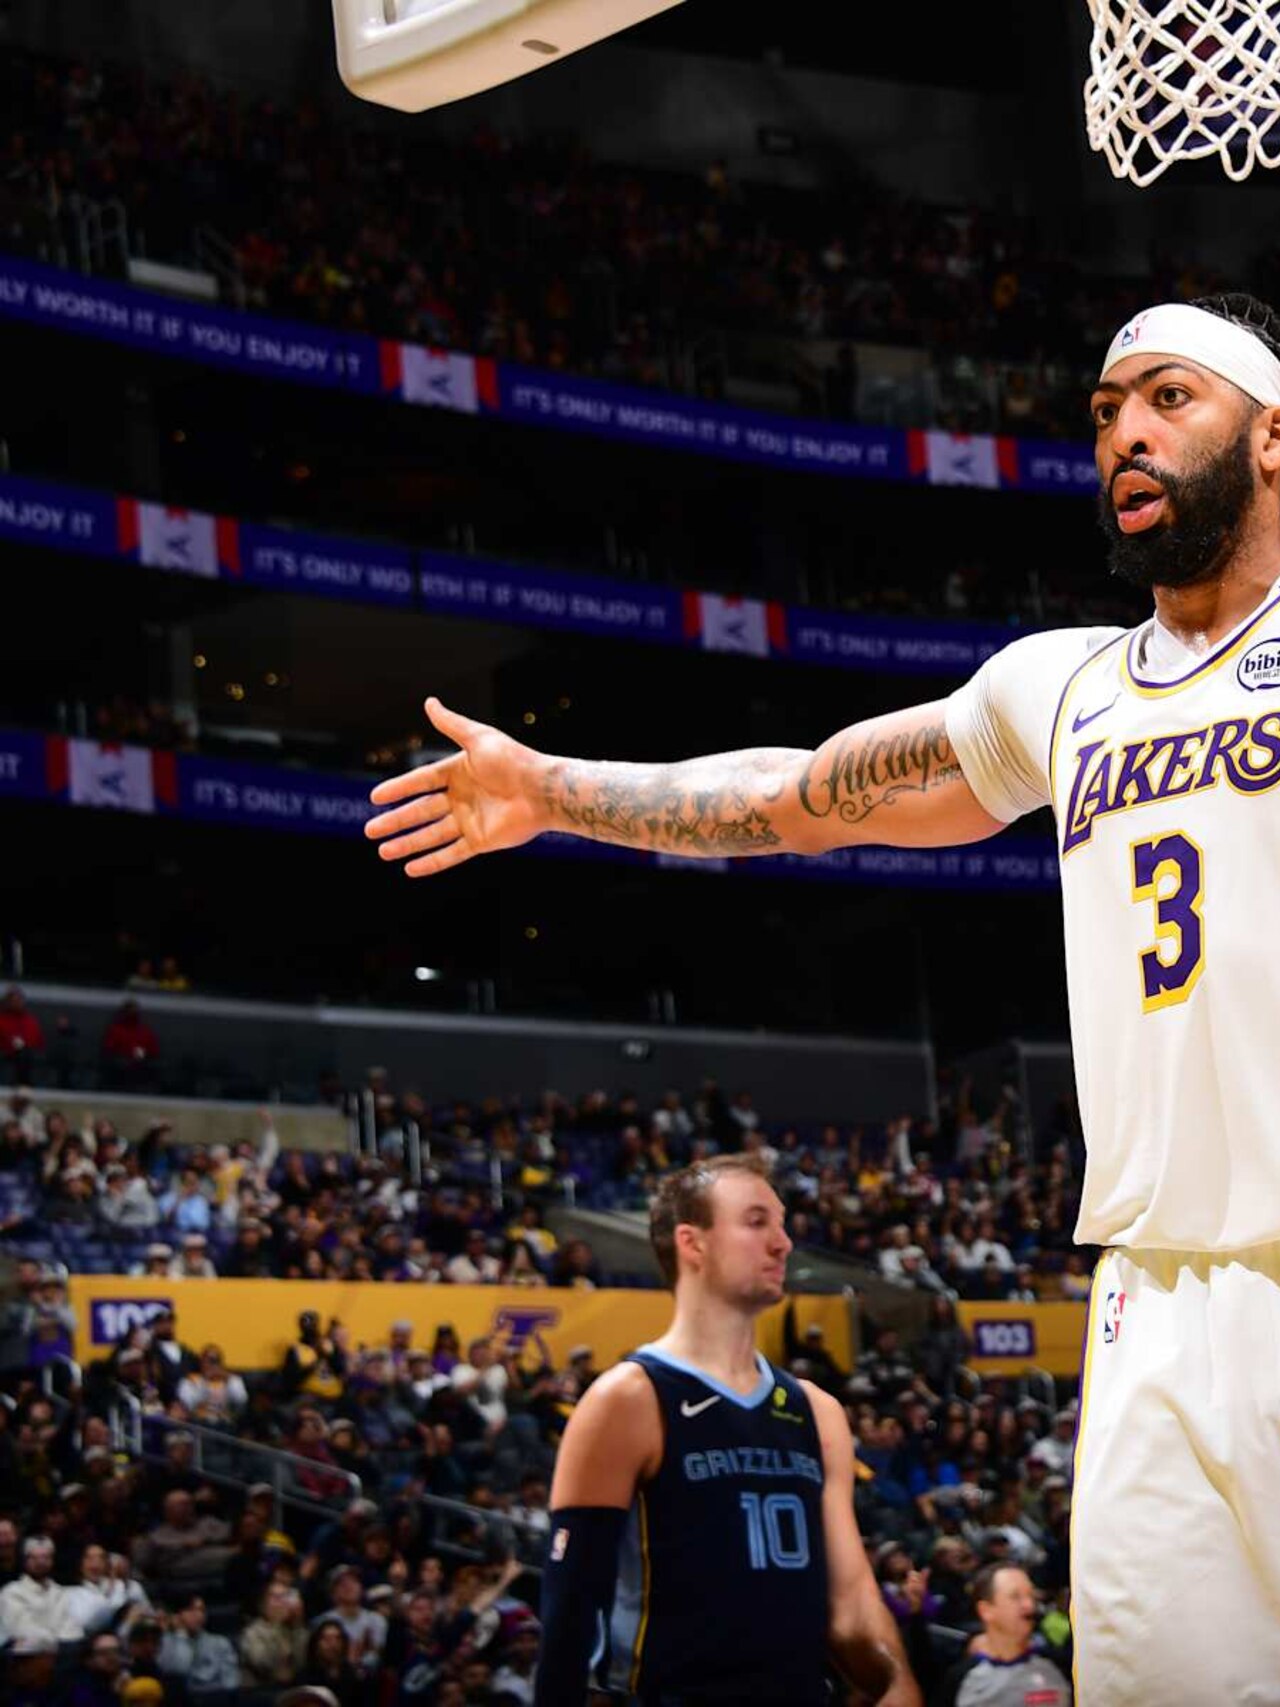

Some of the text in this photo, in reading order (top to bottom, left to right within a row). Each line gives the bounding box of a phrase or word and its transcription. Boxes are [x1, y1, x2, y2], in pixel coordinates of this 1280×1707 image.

[33, 282, 129, 330] WORTH
[132, 308, 156, 335] IT
[160, 315, 183, 341] IF
[186, 320, 243, 357] YOU
[245, 334, 328, 374] ENJOY
[333, 350, 361, 379] IT
[512, 383, 552, 415] IT'S
[556, 392, 616, 425] ONLY
[618, 406, 699, 439] WORTH
[745, 426, 788, 456] YOU
[791, 435, 863, 466] ENJOY
[1031, 456, 1070, 483] IT'S
[69, 509, 97, 539] IT
[255, 545, 668, 629] IT'S ONLY WORTH IT IF YOU ENJOY IT
[797, 625, 835, 653] IT'S
[838, 632, 890, 660] ONLY
[893, 639, 975, 662] WORTH
[193, 778, 240, 812] IT'S
[243, 784, 304, 822] ONLY
[1130, 829, 1206, 1014] 3
[740, 1491, 811, 1570] 10
